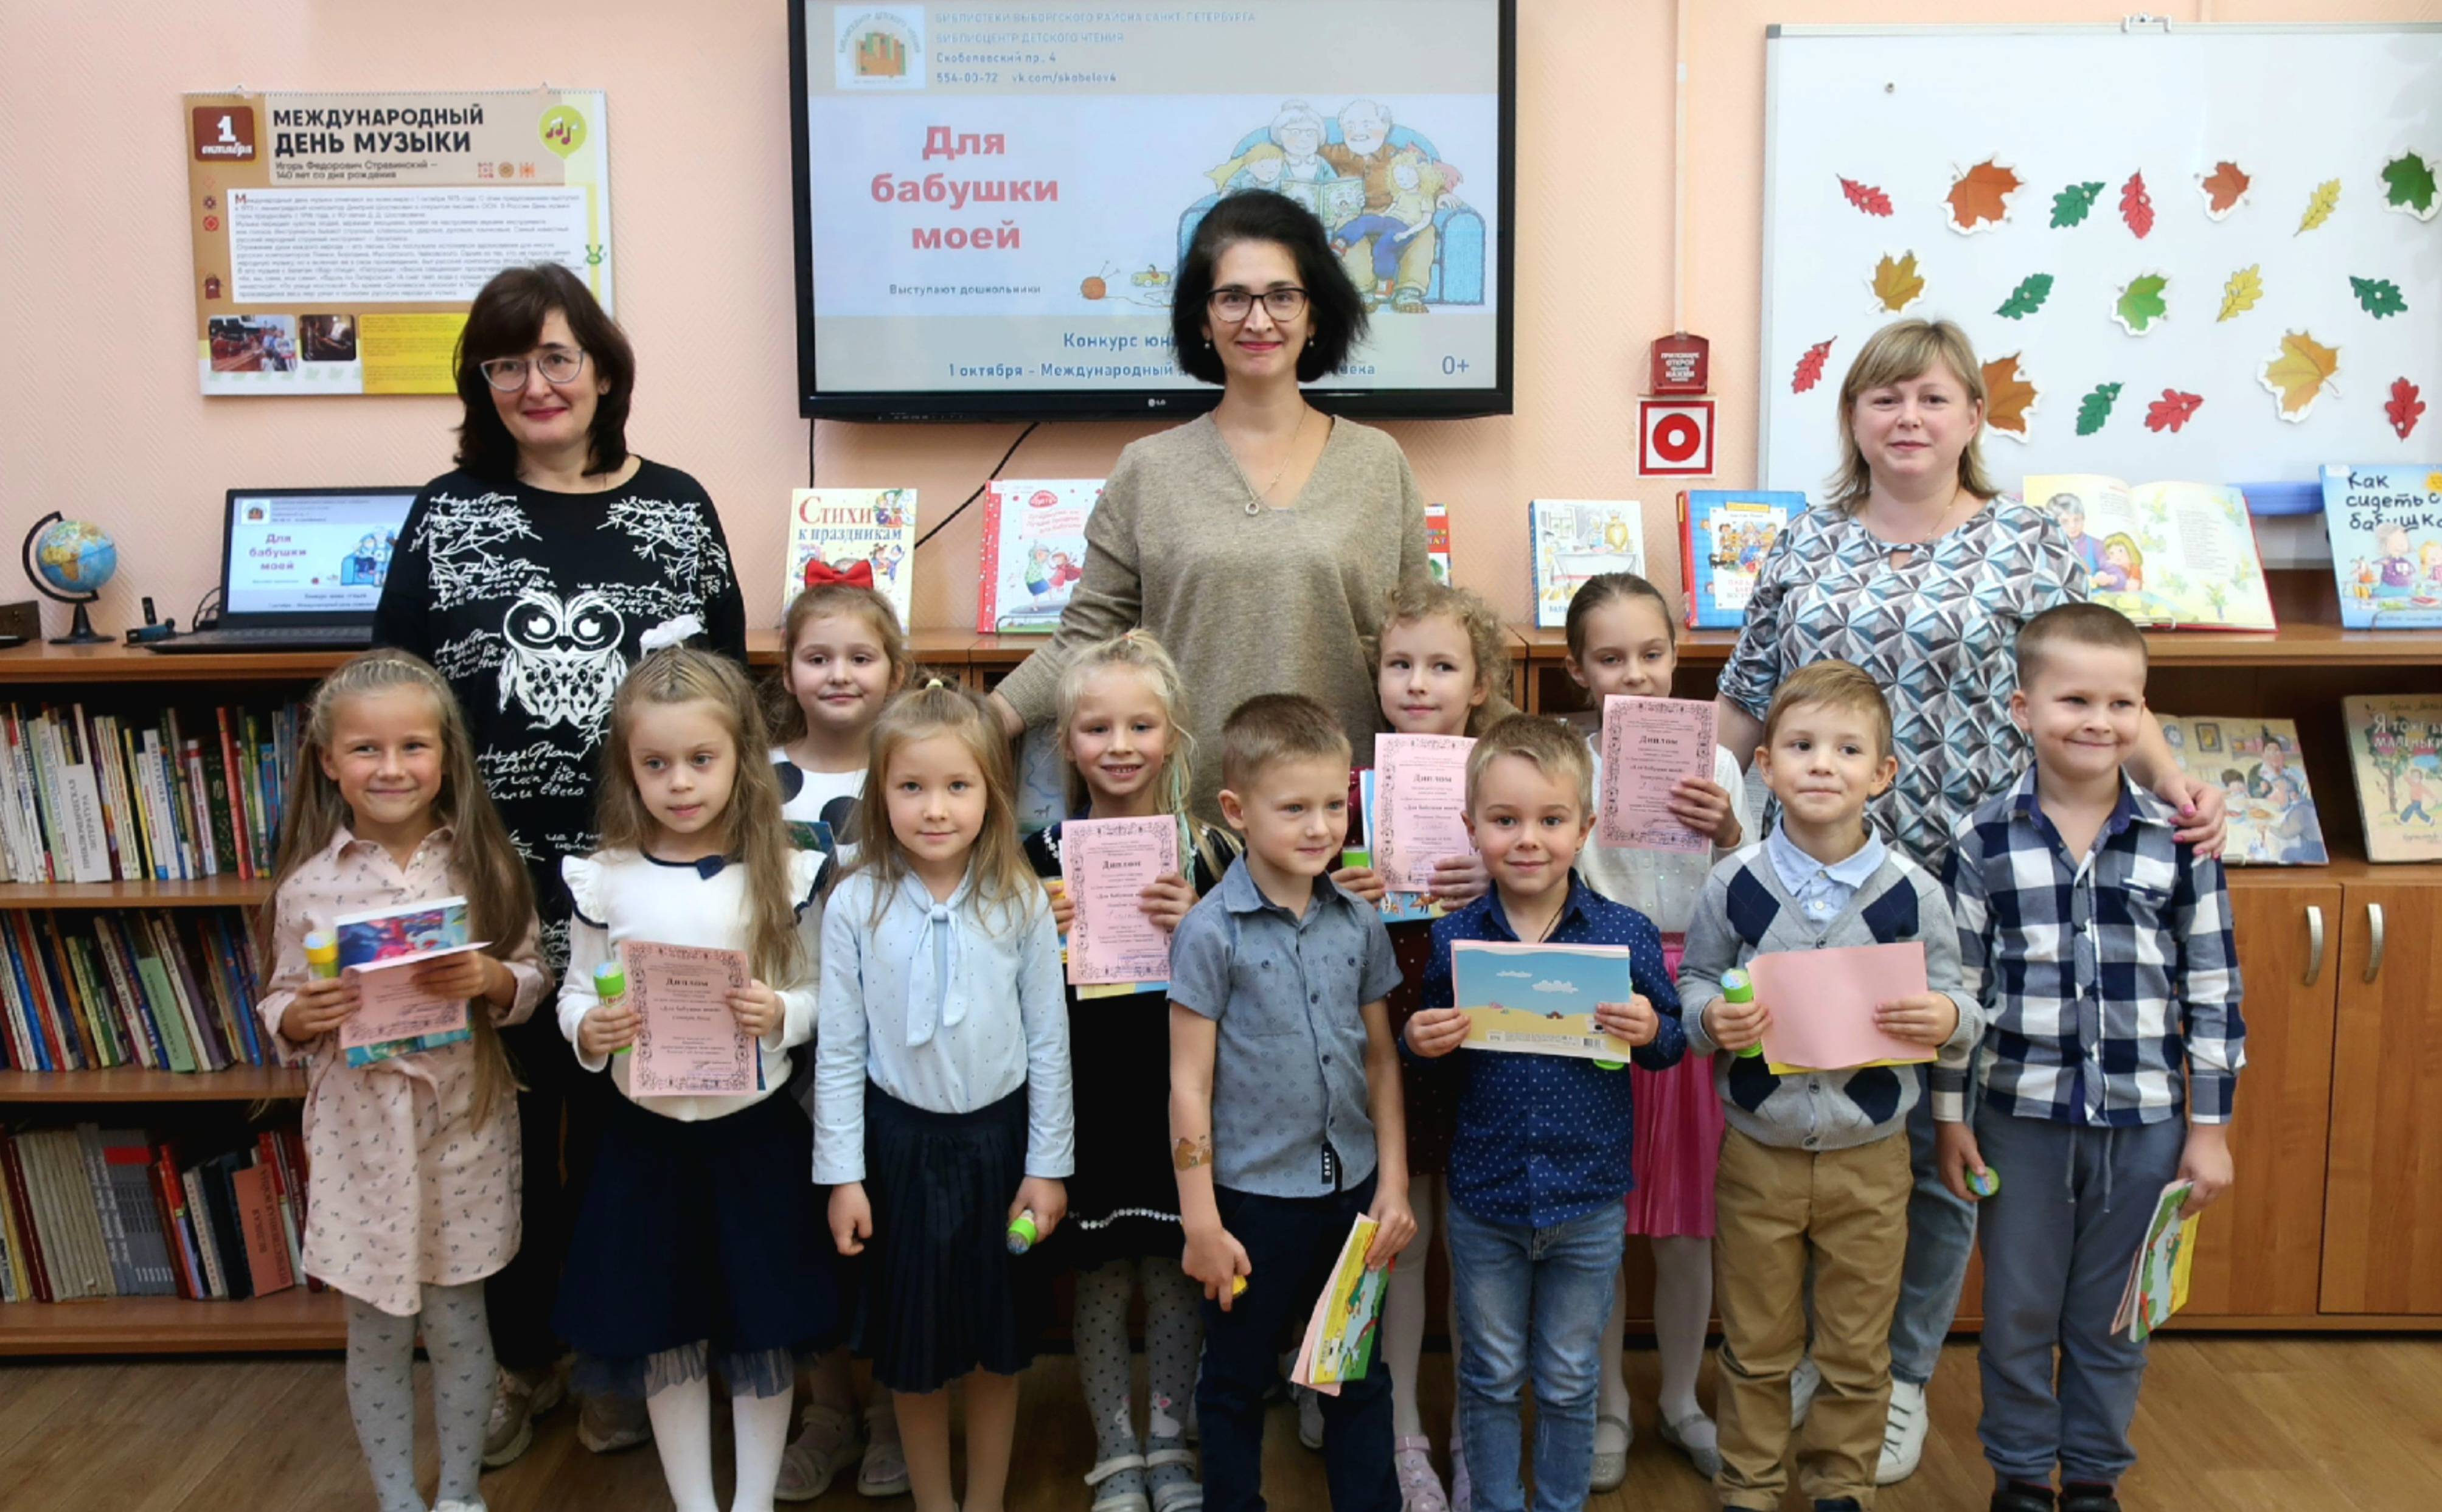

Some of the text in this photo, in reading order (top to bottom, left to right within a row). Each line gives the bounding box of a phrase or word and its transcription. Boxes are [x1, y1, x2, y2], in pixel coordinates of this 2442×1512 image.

[936, 32, 1124, 44] БИБЛИОЦЕНТР ДЕТСКОГО ЧТЕНИЯ
[936, 52, 1022, 63] Скобелевский
[1049, 52, 1057, 62] 4
[274, 103, 484, 129] МЕЖДУНАРОДНЫЙ
[217, 115, 237, 142] 1
[201, 142, 253, 157] октября
[275, 131, 471, 158] ДЕНЬ МУЗЫКИ
[922, 126, 1006, 161] Для
[275, 161, 303, 171] Игорь
[871, 173, 1059, 211] бабушки
[911, 220, 1021, 250] моей
[889, 284, 1041, 297] Выступают дошкольники
[1063, 333, 1138, 352] Конкурс
[948, 364, 955, 377] 1
[959, 364, 1023, 378] октября
[1041, 362, 1174, 379] Международный
[1441, 355, 1470, 375] 0+
[2347, 471, 2390, 490] Как
[798, 495, 874, 525] Стихи
[2346, 493, 2424, 514] сидеть
[266, 534, 291, 544] Для
[798, 527, 902, 545] к праздникам
[249, 548, 306, 558] бабушки
[2374, 712, 2387, 733] Я
[2374, 736, 2442, 749] МАЛЕНЬКИ
[83, 795, 97, 849] ЛИТЕРАТУРА
